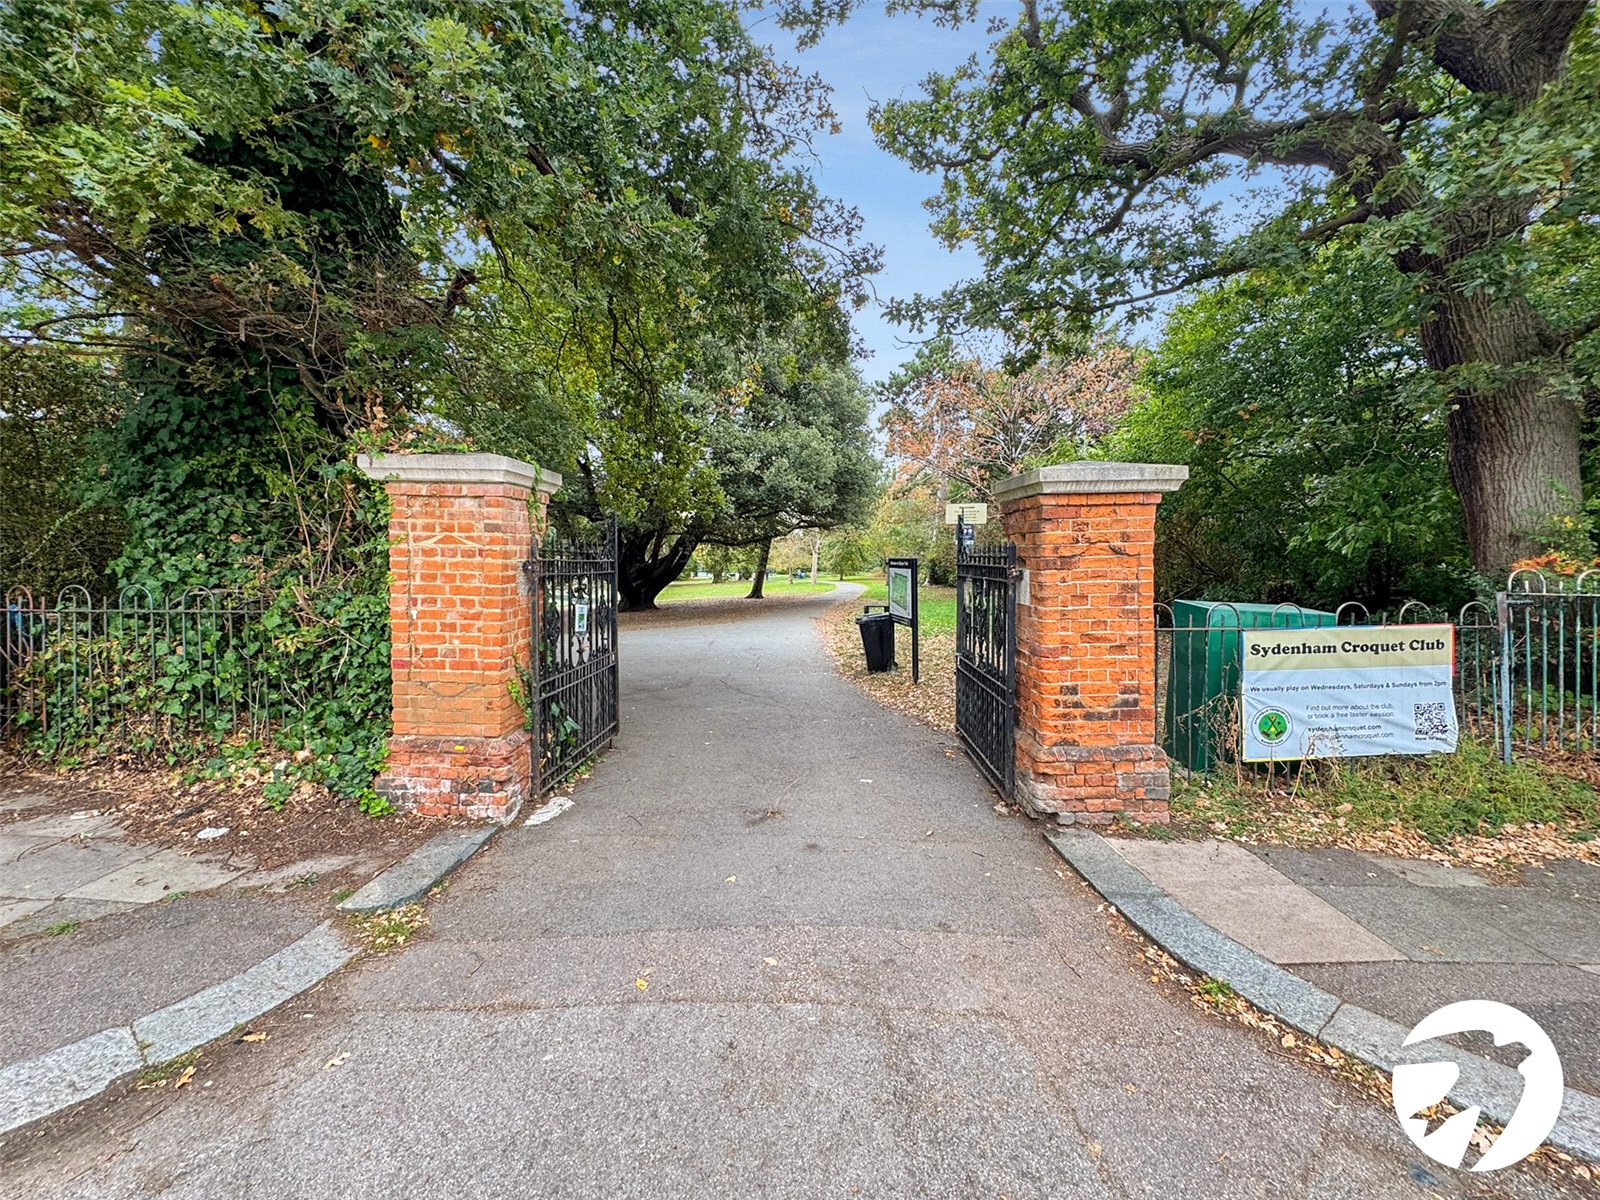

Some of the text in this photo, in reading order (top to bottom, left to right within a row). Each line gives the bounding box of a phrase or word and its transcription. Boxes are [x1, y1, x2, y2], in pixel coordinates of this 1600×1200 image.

[1250, 638, 1445, 658] Sydenham Croquet Club
[1308, 724, 1382, 733] sydenhamcroquet.com
